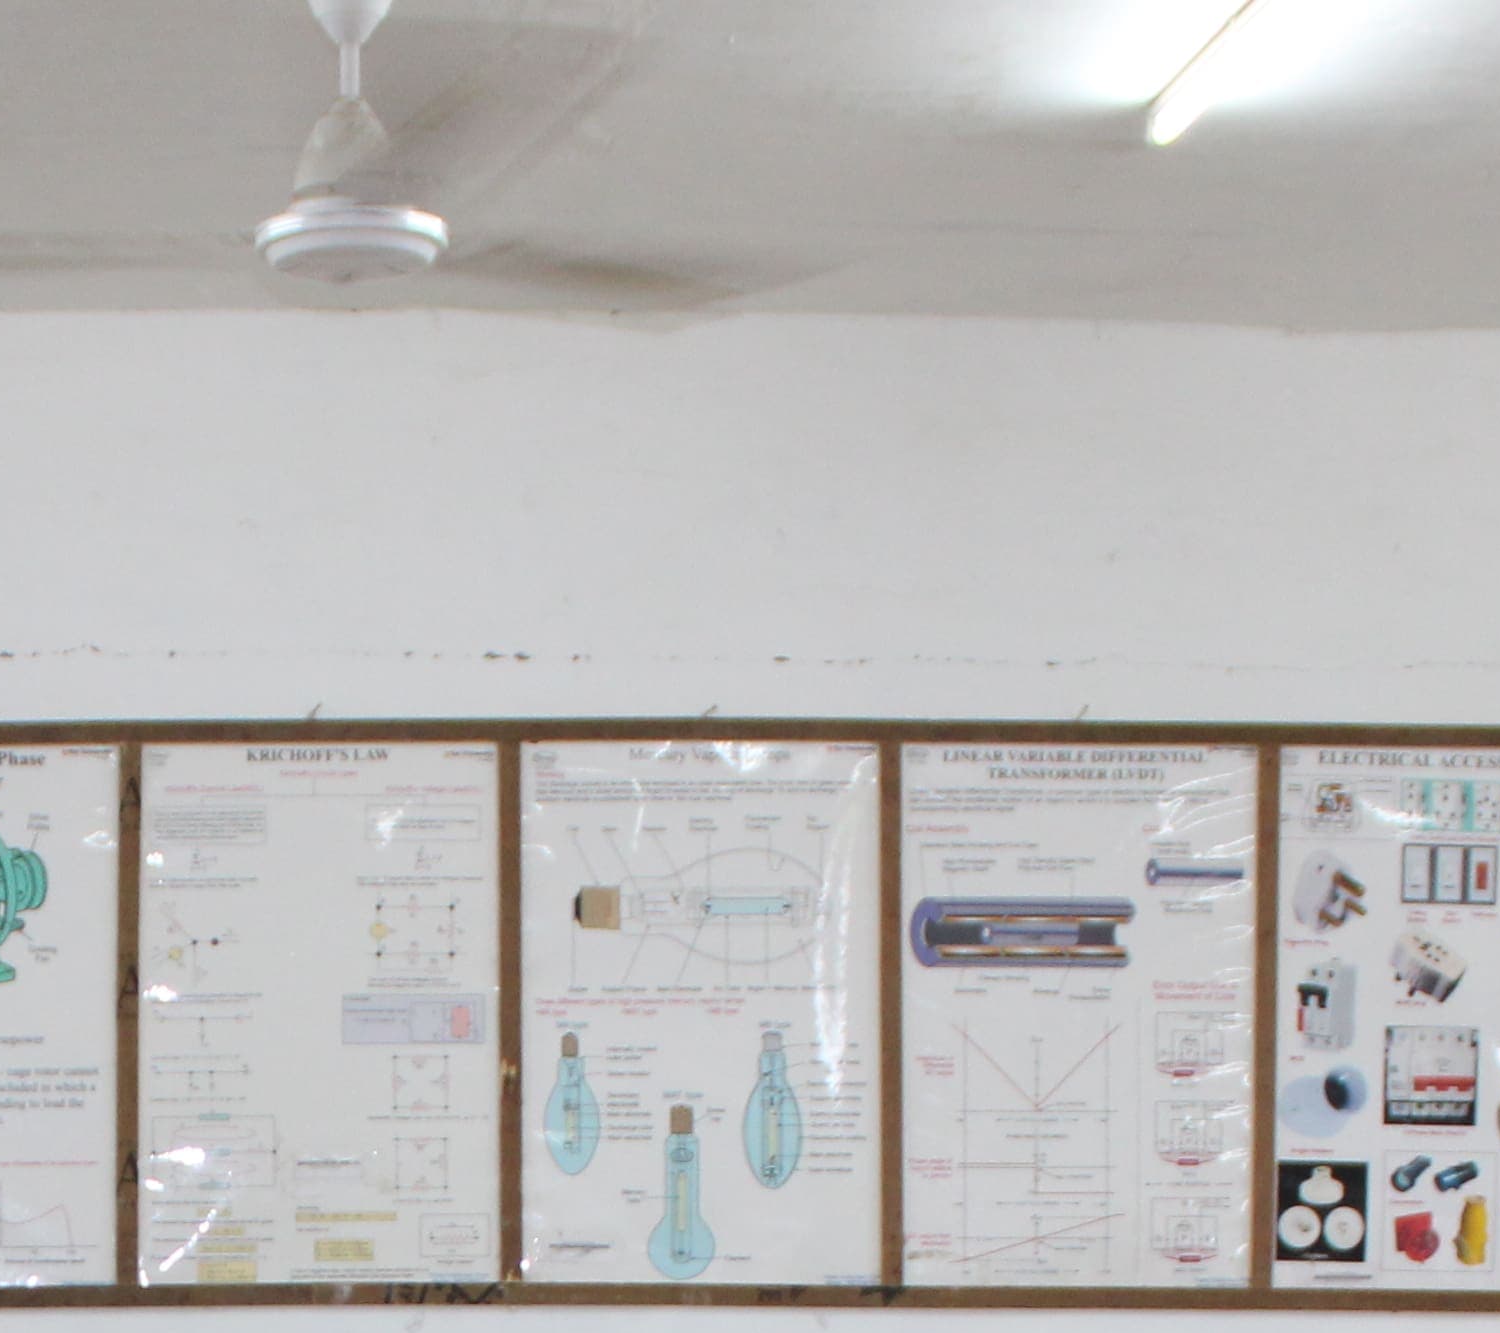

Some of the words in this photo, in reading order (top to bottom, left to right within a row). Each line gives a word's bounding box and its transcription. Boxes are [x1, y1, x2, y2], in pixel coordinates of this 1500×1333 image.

[247, 748, 349, 762] KRICHOFF'S
[354, 748, 390, 761] LAW
[943, 750, 1001, 763] LINEAR
[1009, 750, 1084, 763] VARIABLE
[1092, 750, 1207, 763] DIFFERENTIAL
[1318, 751, 1432, 768] ELECTRICAL
[988, 767, 1107, 782] TRANSFORMER
[1113, 767, 1165, 782] (LVDT)
